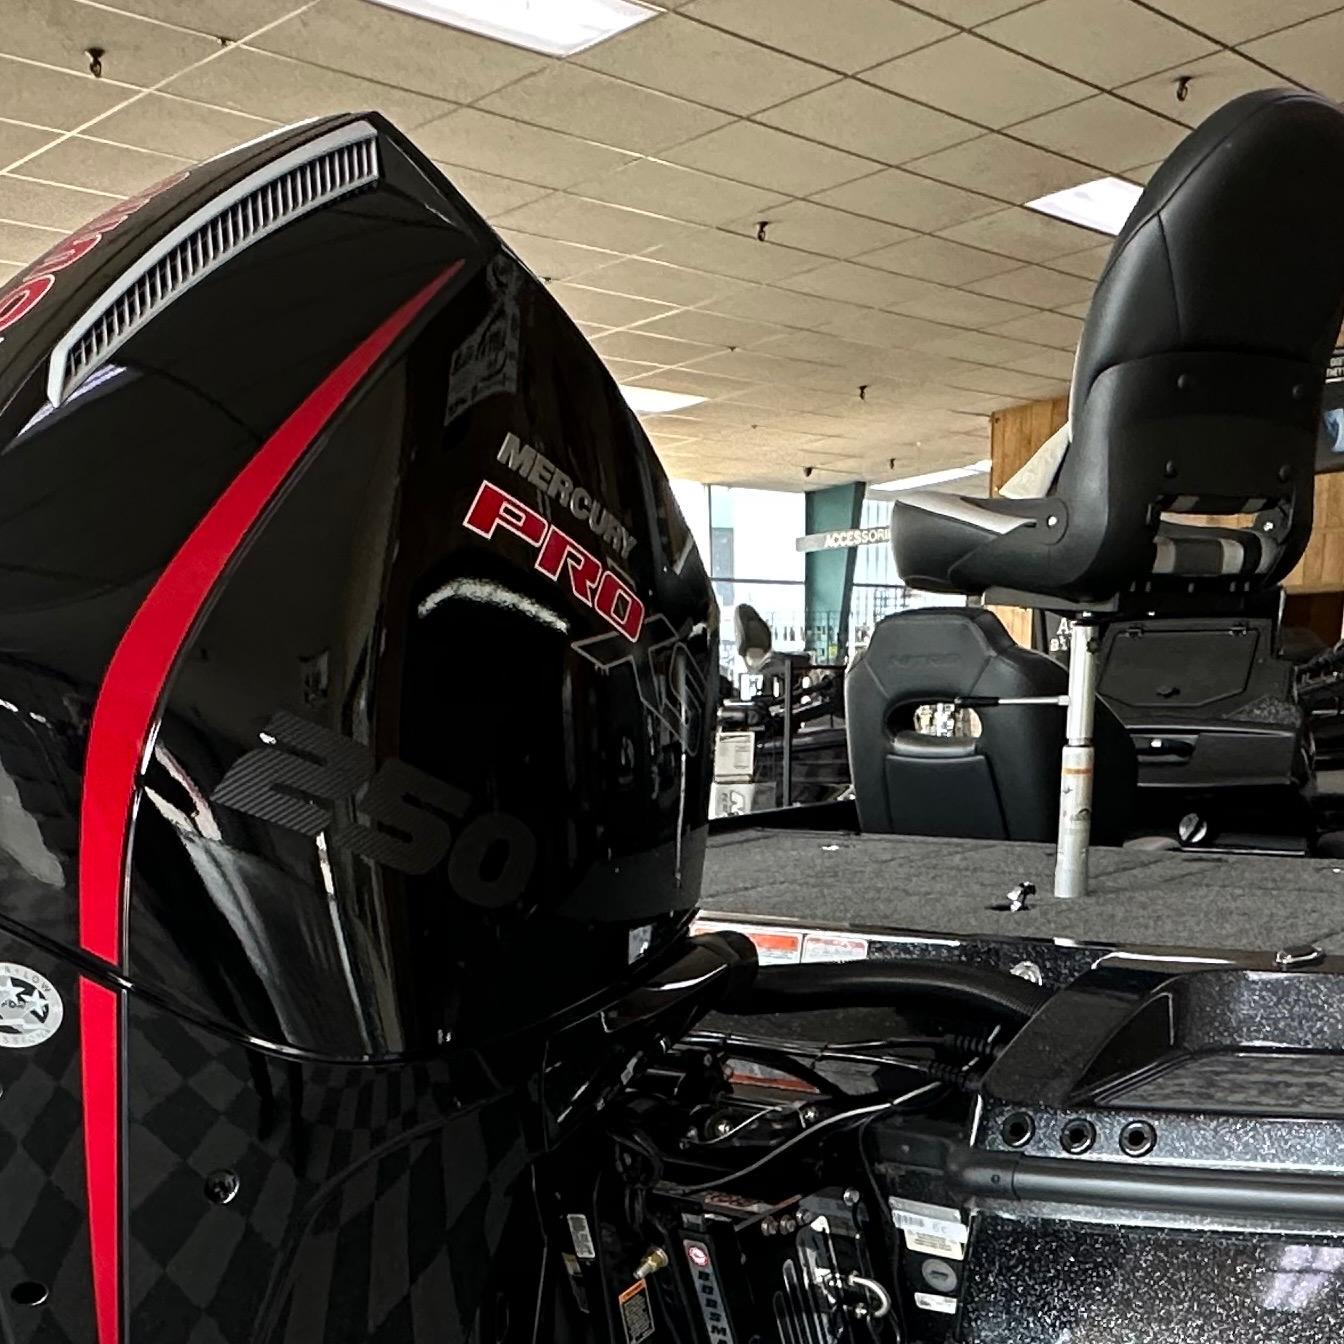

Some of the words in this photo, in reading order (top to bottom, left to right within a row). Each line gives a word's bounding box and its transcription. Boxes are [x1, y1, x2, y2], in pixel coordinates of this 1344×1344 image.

[462, 480, 645, 643] PRO
[497, 432, 637, 559] MERCURY
[824, 528, 891, 548] ACCESSORI
[209, 710, 538, 908] 250
